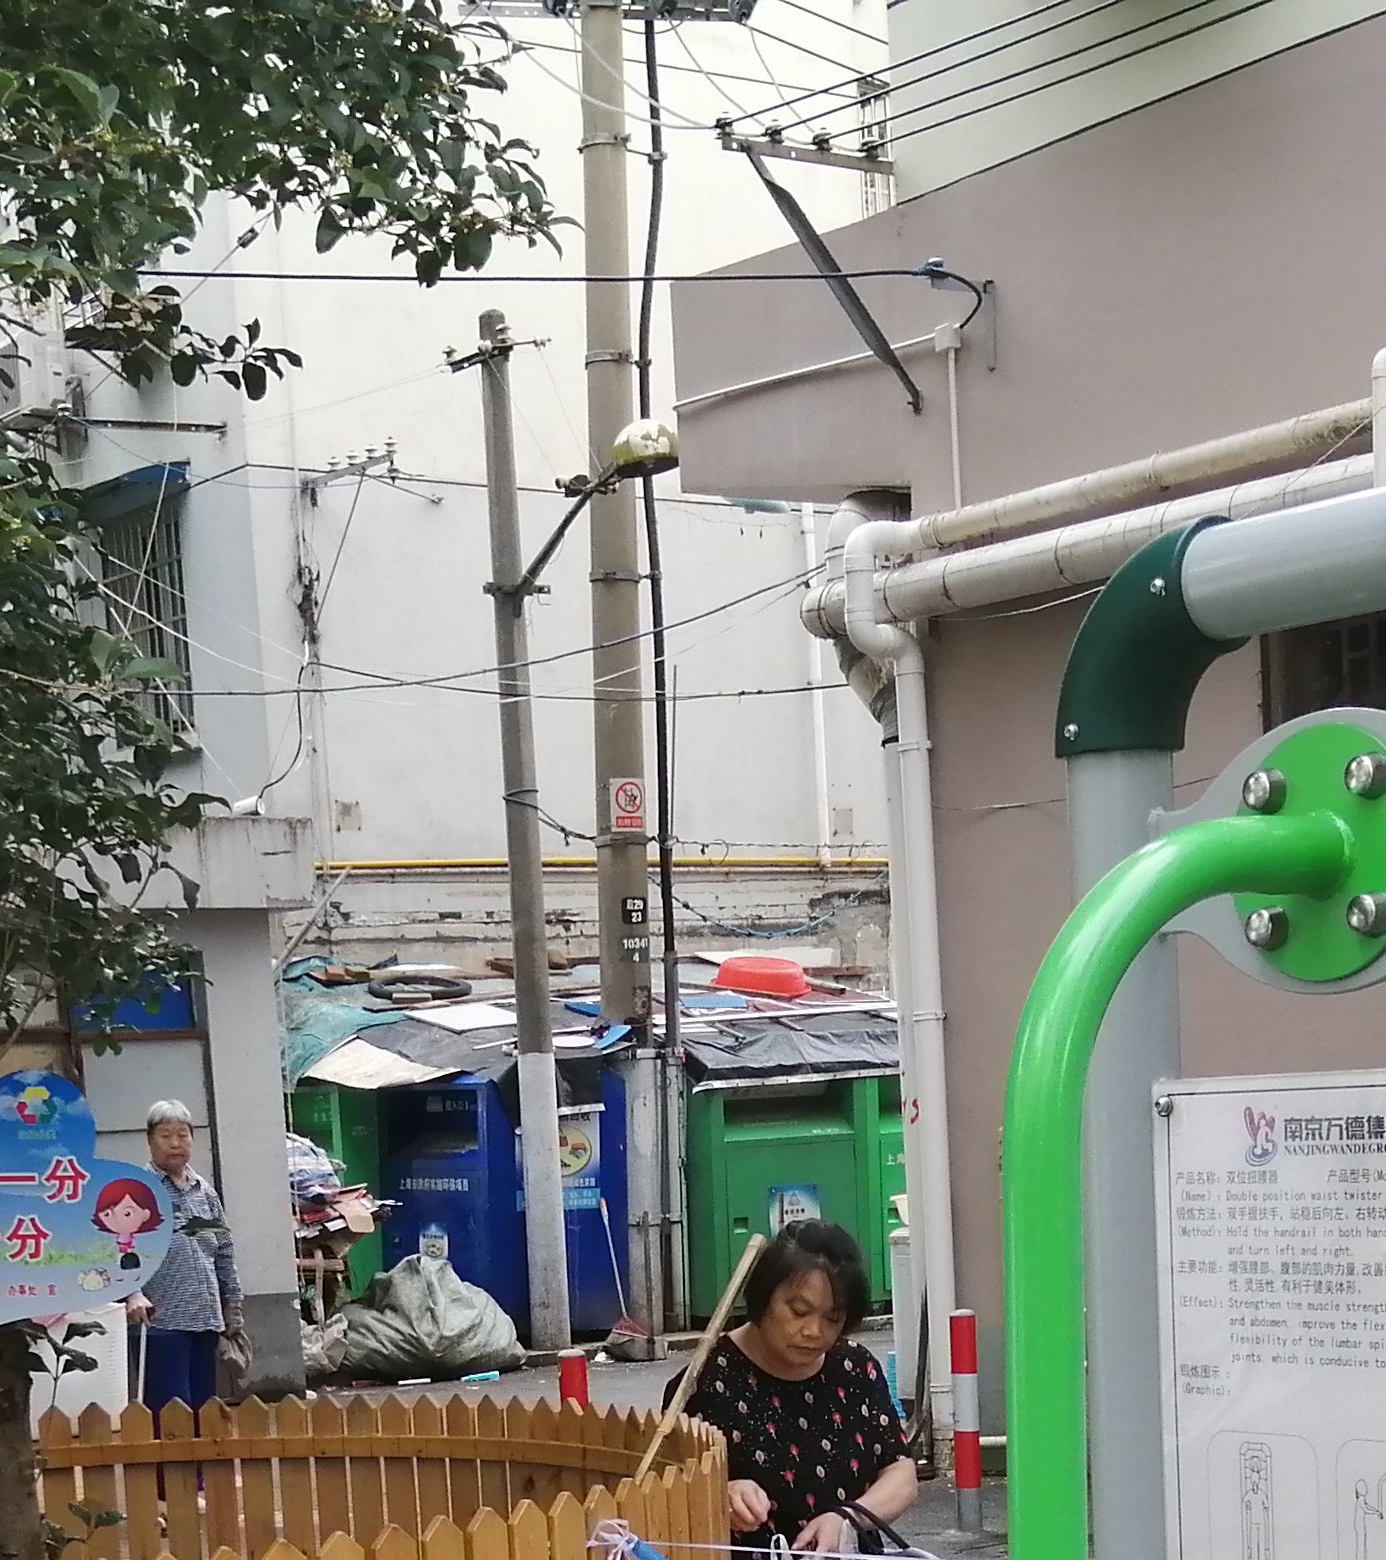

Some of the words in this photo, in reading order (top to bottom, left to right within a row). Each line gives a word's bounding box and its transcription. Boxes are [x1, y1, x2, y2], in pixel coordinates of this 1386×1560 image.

[631, 912, 642, 922] 23
[1226, 1191, 1258, 1201] Double
[1262, 1190, 1306, 1202] position
[1311, 1190, 1338, 1201] waist
[1344, 1190, 1383, 1200] twister
[1227, 1226, 1249, 1237] Hold
[1254, 1226, 1269, 1237] the
[1274, 1226, 1316, 1237] handrail
[1324, 1227, 1333, 1237] in
[1339, 1227, 1361, 1237] both
[1228, 1245, 1243, 1255] and
[1249, 1245, 1270, 1255] turn
[1276, 1245, 1295, 1255] left
[1301, 1245, 1317, 1256] and
[1323, 1246, 1353, 1258] right.
[1178, 1260, 1222, 1274] 主要功能：
[1228, 1299, 1281, 1310] Strengthen
[1286, 1300, 1303, 1310] the
[1307, 1301, 1340, 1311] muscle
[1229, 1317, 1245, 1326] and
[1299, 1319, 1335, 1330] improve
[1341, 1319, 1358, 1330] the
[1230, 1334, 1287, 1347] flexibility
[1292, 1336, 1303, 1346] of
[1309, 1337, 1325, 1347] the
[1331, 1338, 1362, 1349] lumbar
[1271, 1354, 1298, 1364] which
[1305, 1355, 1314, 1365] is
[1320, 1356, 1369, 1368] conducive
[1375, 1358, 1386, 1368] to
